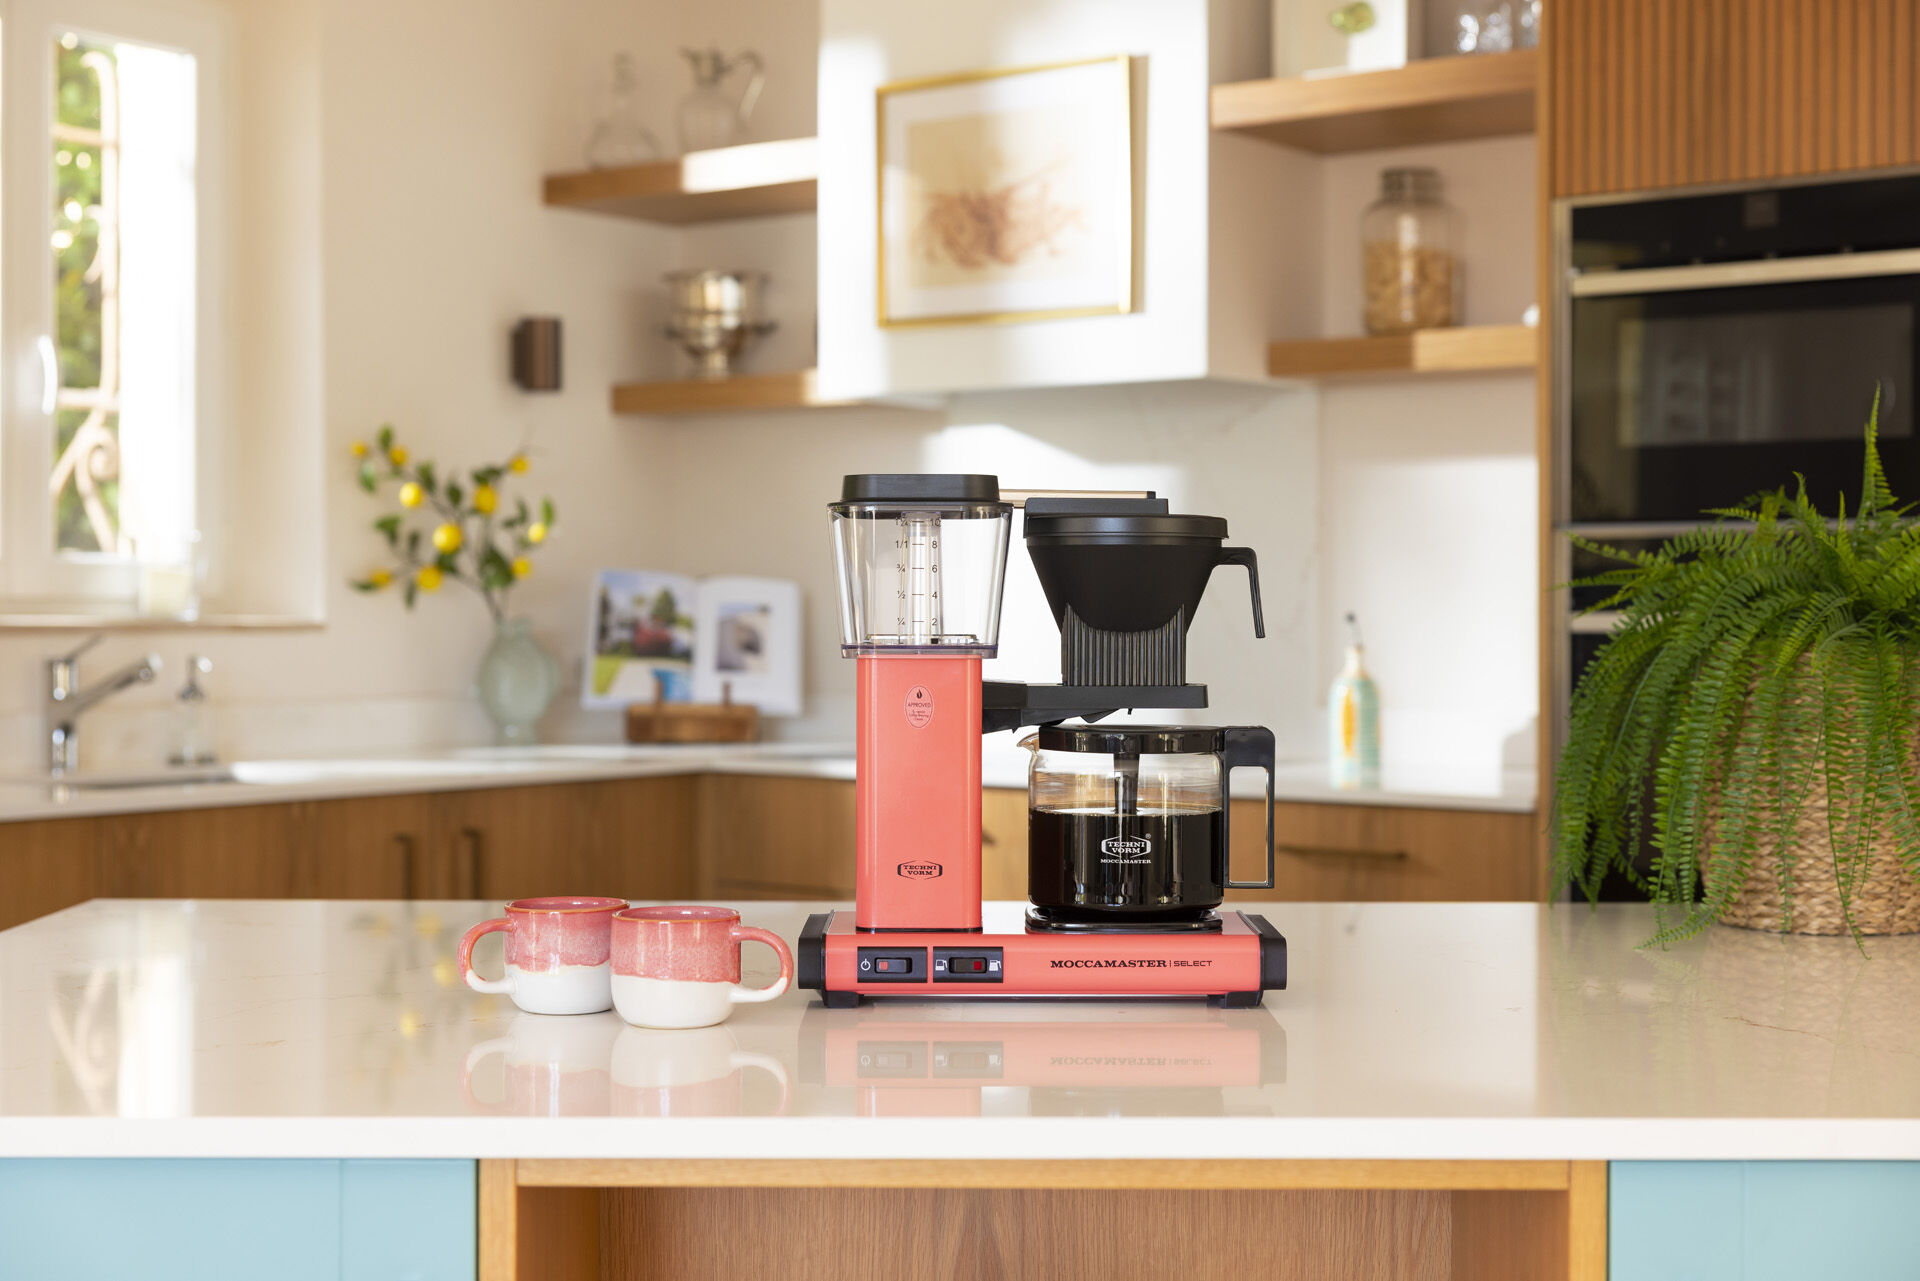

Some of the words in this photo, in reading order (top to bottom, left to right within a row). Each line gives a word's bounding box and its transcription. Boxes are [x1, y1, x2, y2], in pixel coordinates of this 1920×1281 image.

[932, 540, 938, 549] 8
[932, 565, 938, 573] 6
[932, 591, 938, 599] 4
[932, 617, 938, 626] 2
[1050, 960, 1167, 968] MOCCAMASTER
